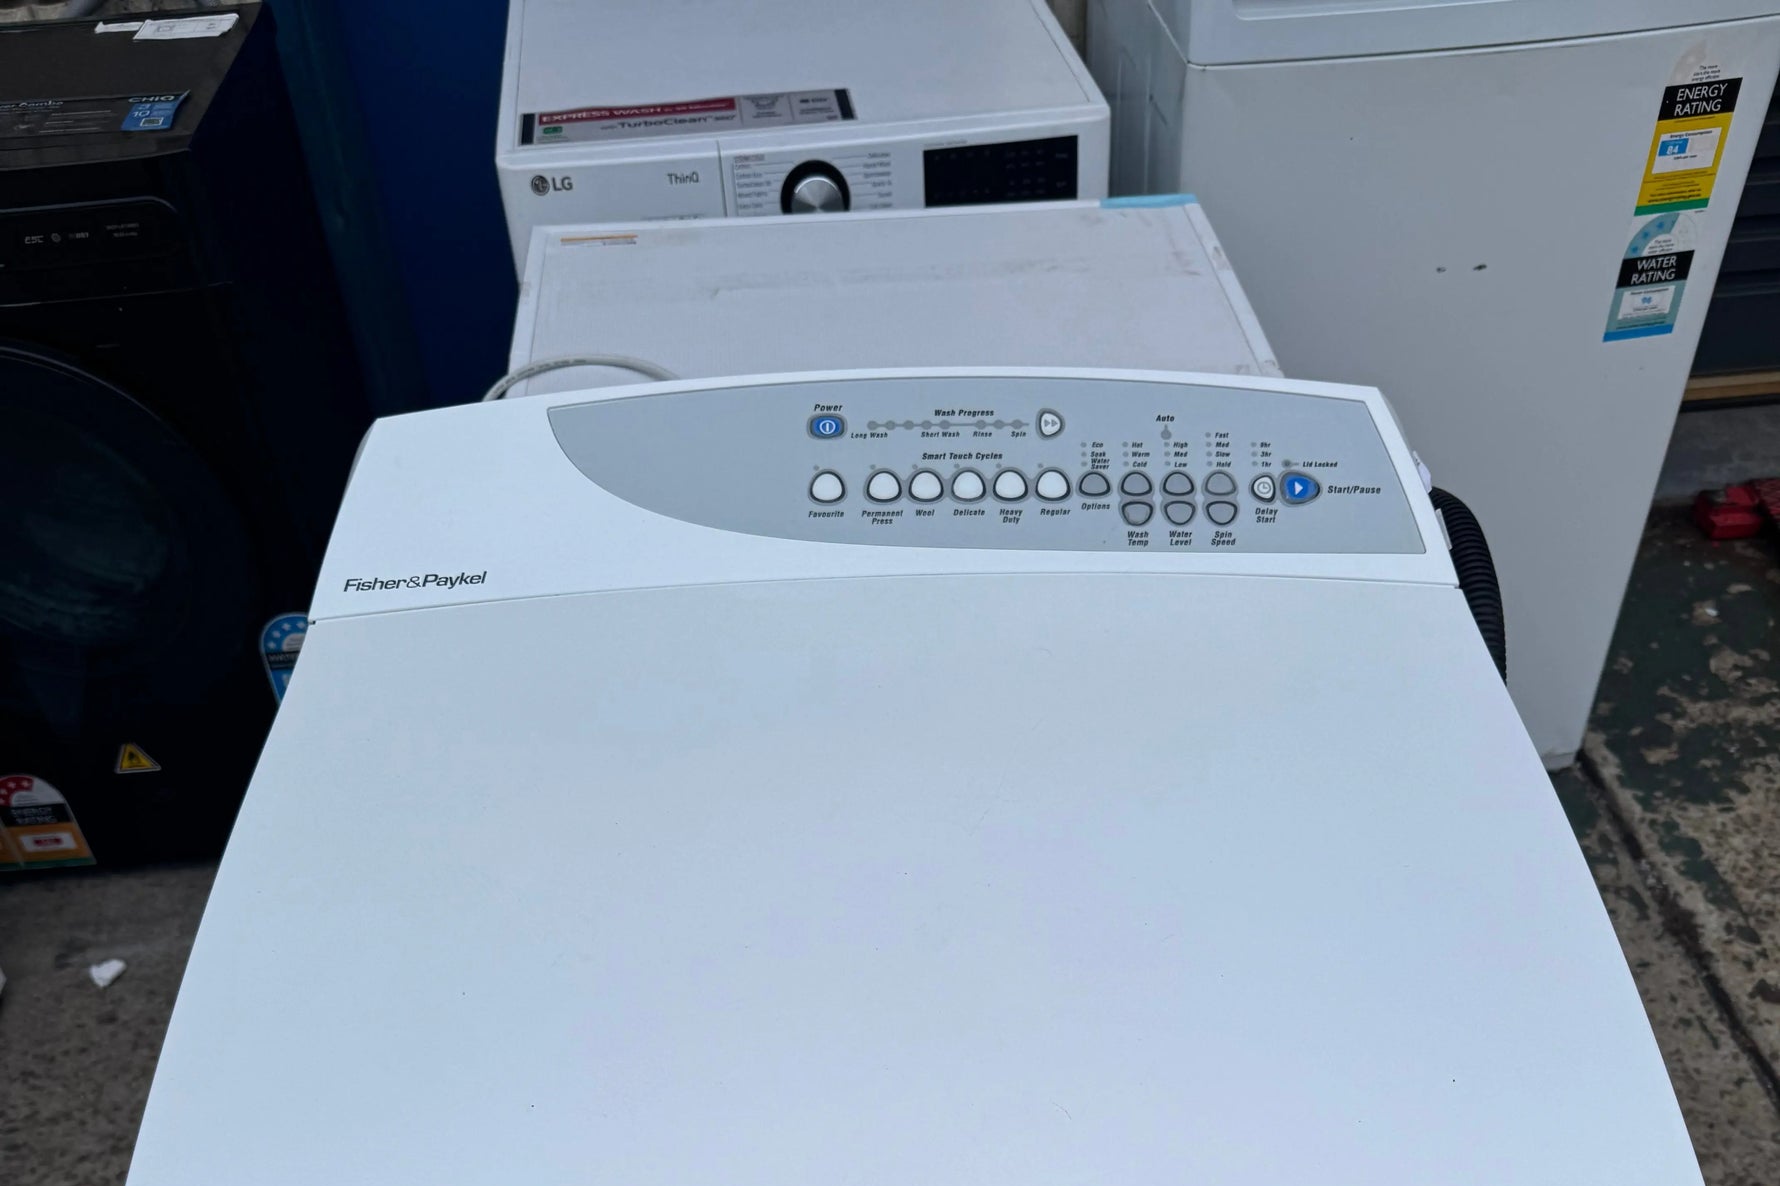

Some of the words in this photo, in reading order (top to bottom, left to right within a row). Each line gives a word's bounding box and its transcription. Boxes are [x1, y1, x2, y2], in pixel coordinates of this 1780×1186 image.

[1676, 83, 1728, 102] ENERGY
[1673, 99, 1722, 117] RATING
[541, 110, 611, 123] EXPRESS
[613, 106, 662, 117] WASH
[667, 171, 699, 185] ThinQ
[552, 176, 573, 191] LG
[1637, 255, 1677, 271] WATER
[1630, 269, 1676, 285] RATING
[814, 404, 843, 412] Power
[934, 409, 955, 417] Wash
[958, 409, 994, 418] Progress
[1156, 414, 1175, 422] Auto
[1011, 431, 1027, 439] Spin
[1173, 441, 1188, 449] High
[922, 452, 946, 461] Smart
[949, 452, 973, 460] Touch
[975, 452, 1003, 461] Cycles
[1327, 485, 1382, 495] Start/Pause
[1081, 502, 1111, 511] Options
[808, 510, 844, 518] Favourite
[861, 510, 903, 518] Permanent
[915, 509, 935, 517] Wool
[953, 508, 985, 517] Delicate
[1000, 508, 1023, 517] Heavy
[1040, 508, 1071, 517] Regular
[1255, 507, 1278, 516] Delay
[871, 518, 893, 526] Press
[1003, 515, 1020, 525] Duty
[1256, 515, 1276, 523] Start
[1127, 530, 1149, 538] Wash
[1169, 530, 1192, 538] Water
[1214, 530, 1233, 539] Spin
[1128, 538, 1149, 547] Temp
[1170, 538, 1192, 546] Level
[1211, 538, 1236, 547] Speed
[343, 571, 487, 592] Fisher&Paykel
